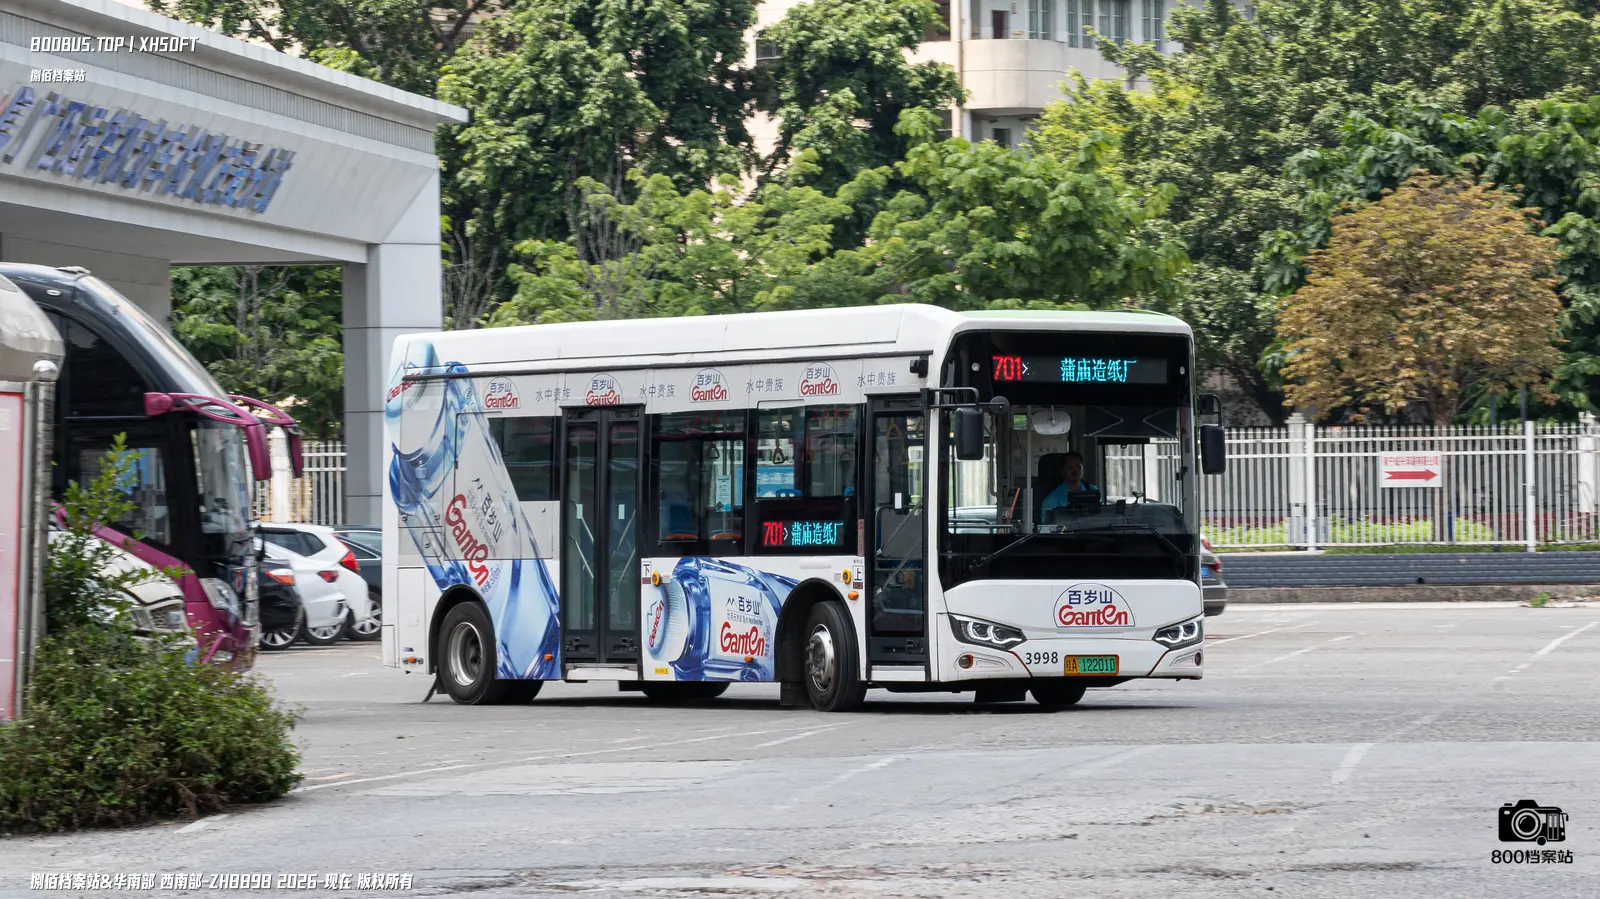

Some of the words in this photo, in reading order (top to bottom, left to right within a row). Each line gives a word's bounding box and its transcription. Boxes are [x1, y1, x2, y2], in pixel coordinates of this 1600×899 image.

[806, 367, 831, 379] 百岁山
[992, 355, 1022, 381] 701
[1060, 357, 1138, 383] 蒲庙造纸厂
[591, 379, 614, 391] 百岁山
[697, 373, 721, 386] 百岁山
[745, 377, 784, 392] 水中贵族
[857, 371, 896, 387] 水中贵族
[490, 382, 513, 393] 百岁山
[536, 387, 571, 402] 水中贵族
[639, 383, 676, 399] 水中贵族
[481, 492, 503, 543] 百岁山
[763, 521, 783, 546] 701
[791, 521, 844, 546] 蒲庙造纸厂
[1068, 590, 1113, 605] 百岁山
[737, 595, 761, 616] 百岁山
[1025, 651, 1059, 665] 3998
